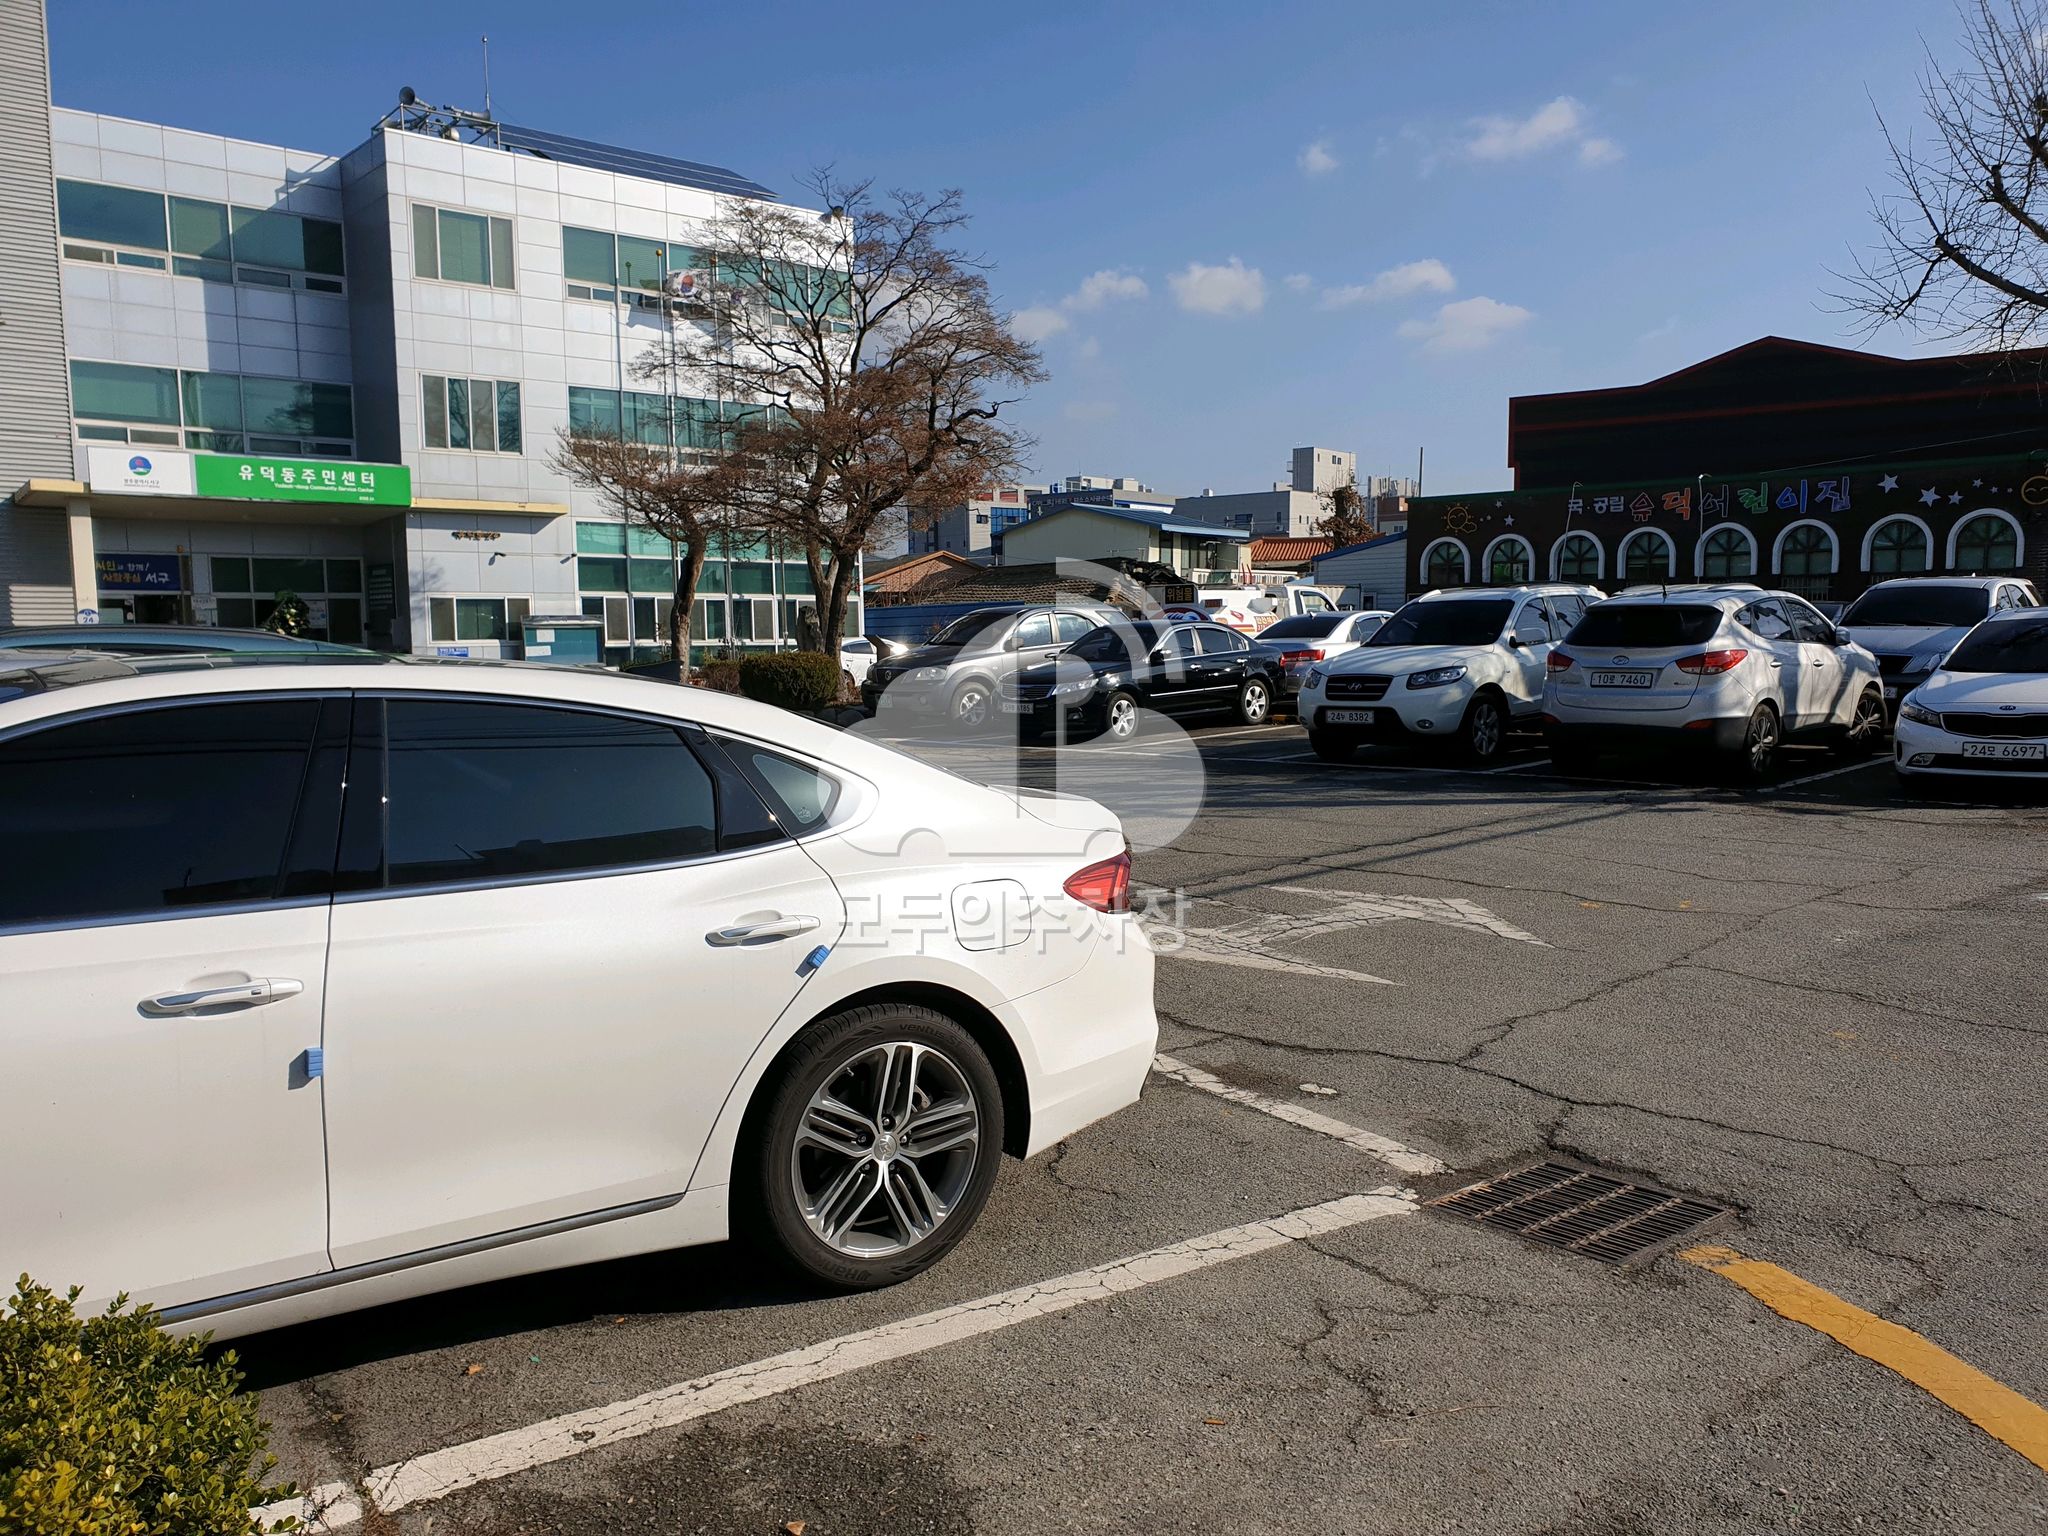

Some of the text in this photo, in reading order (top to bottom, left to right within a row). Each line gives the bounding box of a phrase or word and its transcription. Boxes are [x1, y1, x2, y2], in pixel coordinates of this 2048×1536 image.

[238, 464, 375, 487] 유덕동주민센터
[145, 572, 170, 584] 서구
[1167, 587, 1193, 601] 위험물
[1620, 674, 1646, 685] 7460
[1348, 712, 1369, 722] 8382
[1970, 744, 2038, 757] 24모 6697
